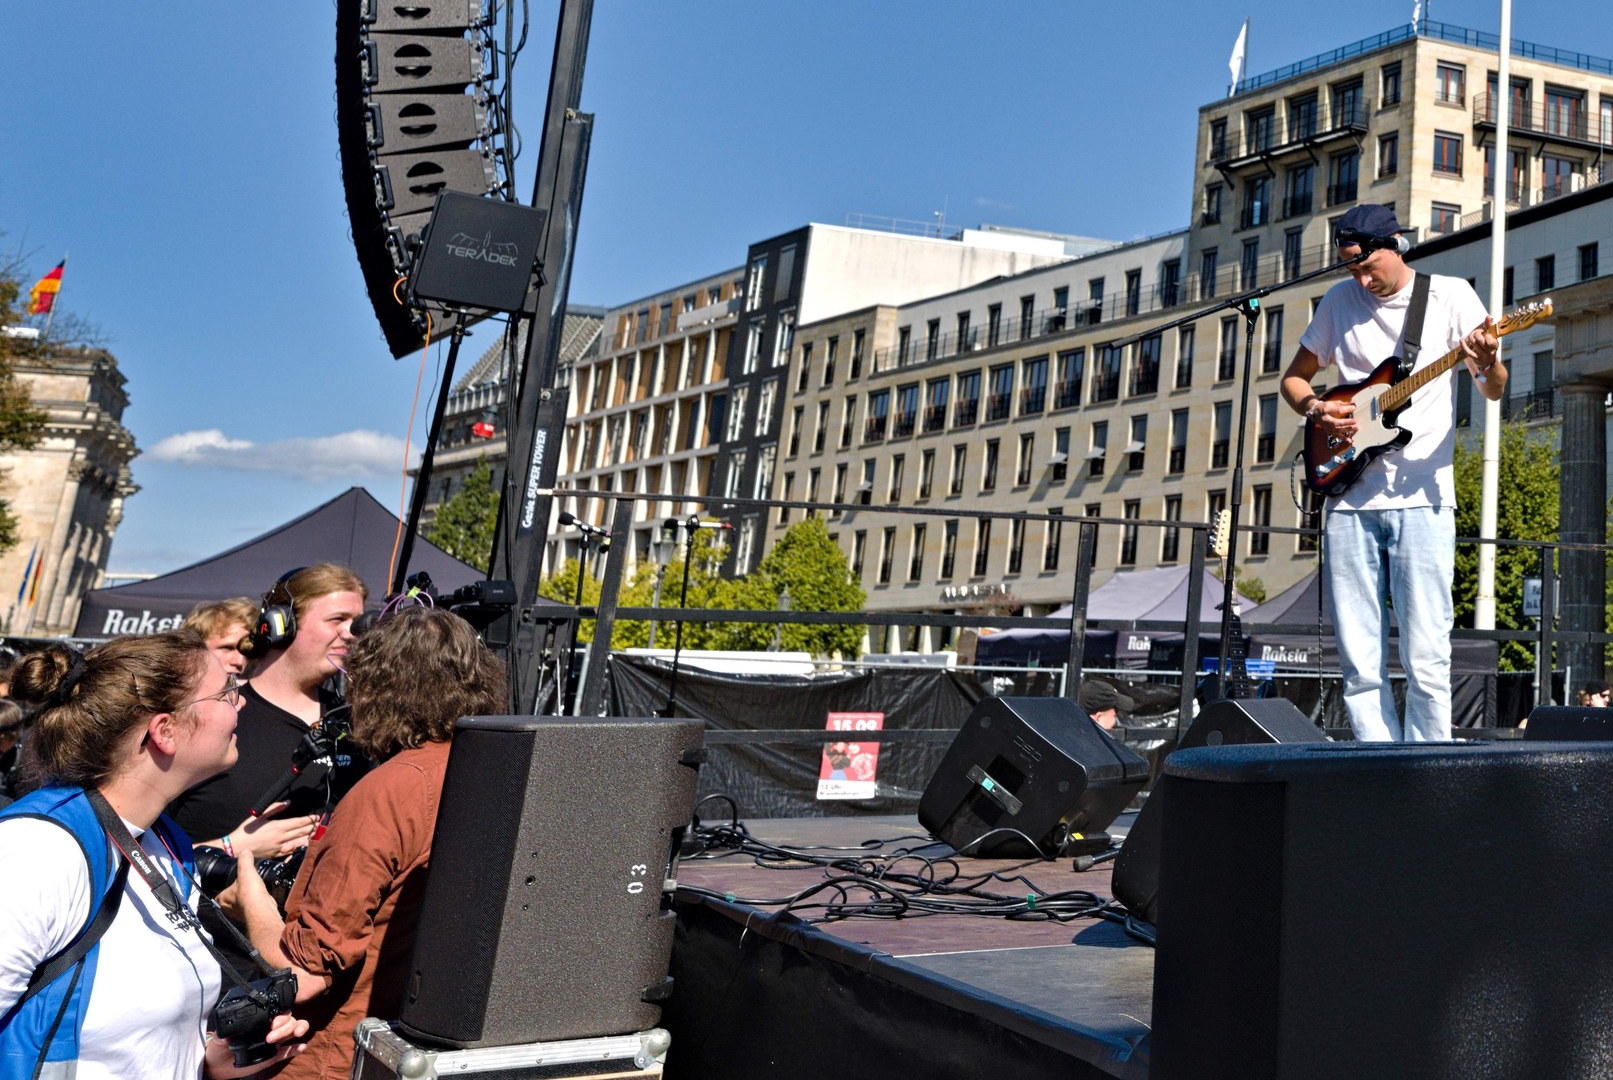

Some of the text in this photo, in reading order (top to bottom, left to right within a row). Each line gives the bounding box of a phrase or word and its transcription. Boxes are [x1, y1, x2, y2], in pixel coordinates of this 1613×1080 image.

[446, 244, 517, 267] TERADEK
[532, 428, 547, 465] TOWER
[527, 464, 541, 500] SUPER
[131, 849, 152, 875] Canon
